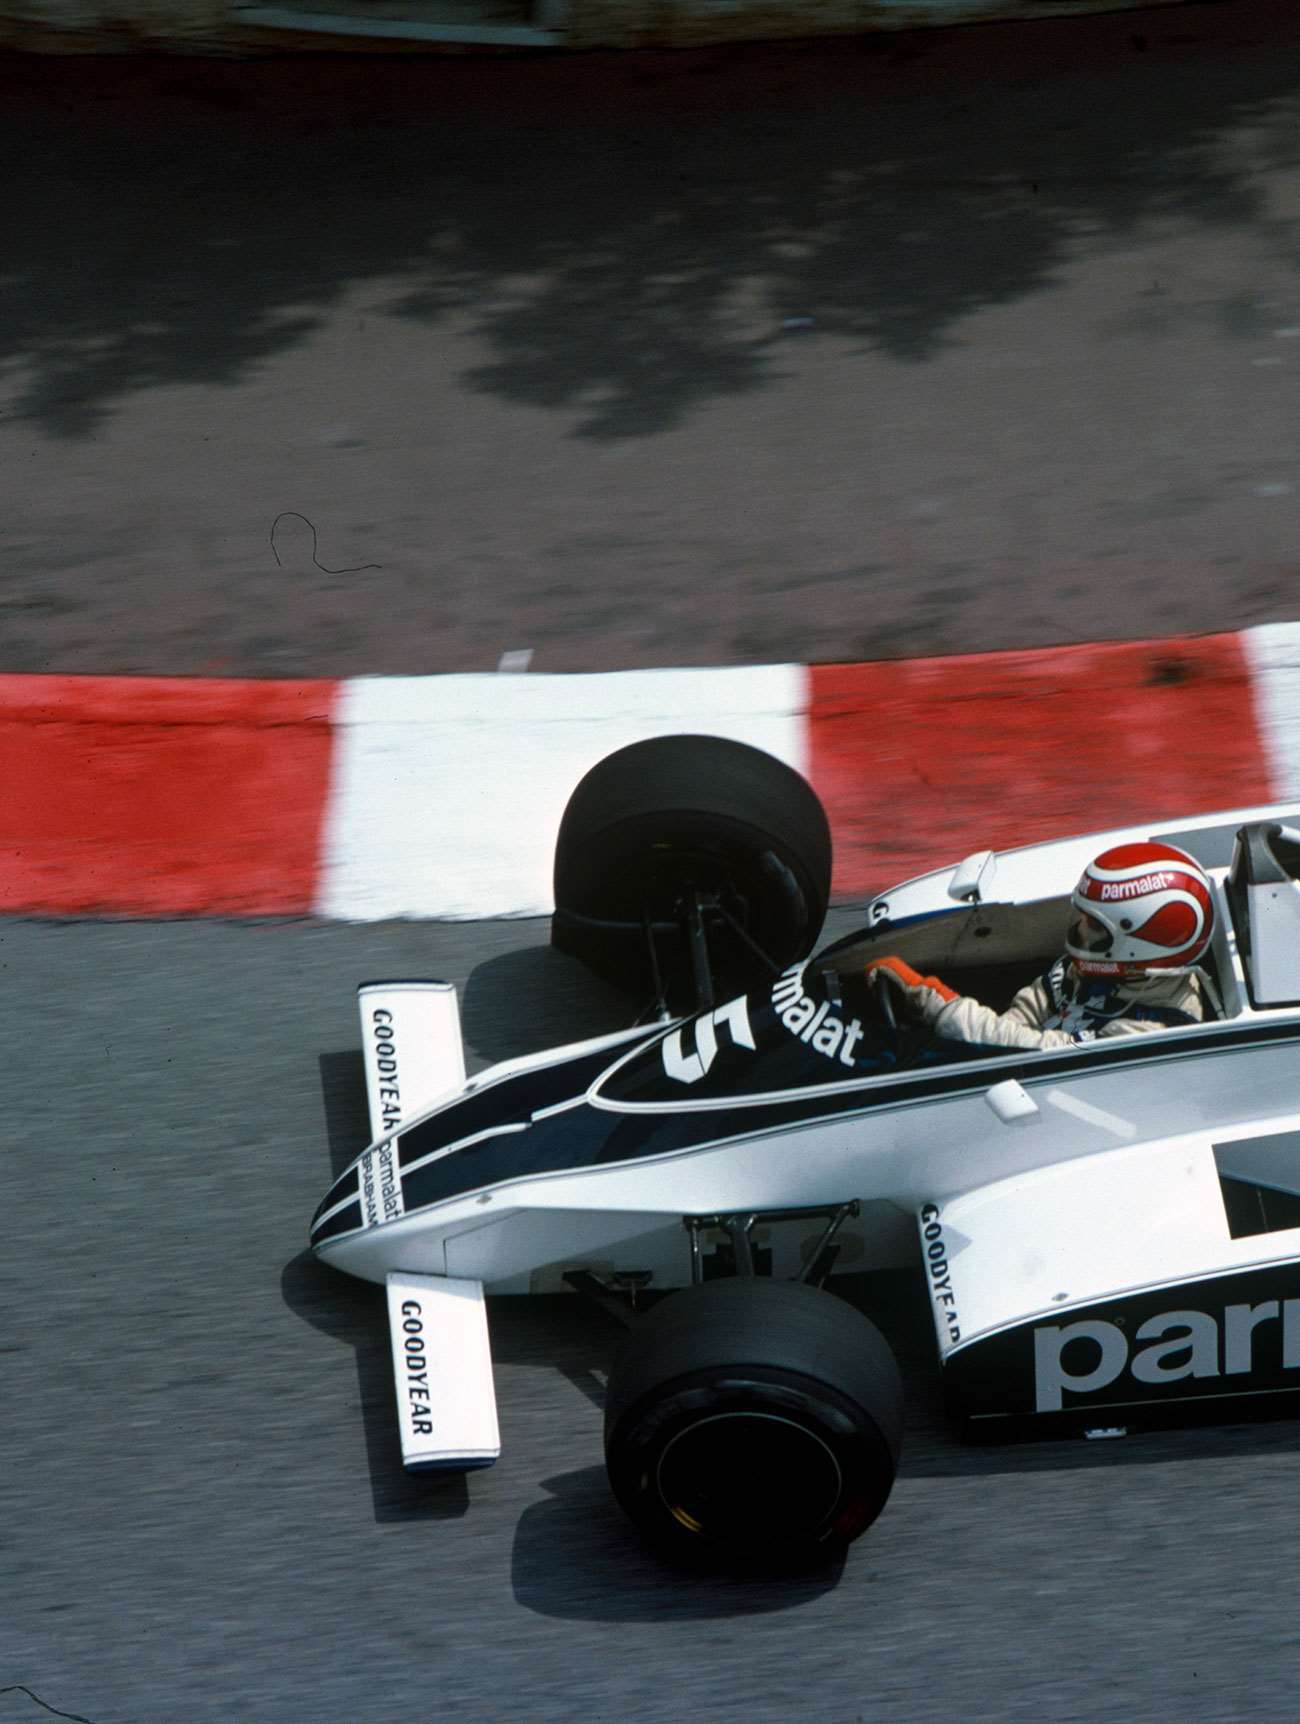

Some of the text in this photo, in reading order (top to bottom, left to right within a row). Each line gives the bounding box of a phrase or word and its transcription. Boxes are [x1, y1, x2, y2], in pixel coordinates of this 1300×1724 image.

[1101, 873, 1168, 900] parmalat
[662, 995, 756, 1084] 5
[401, 1300, 433, 1435] GOODYEAR
